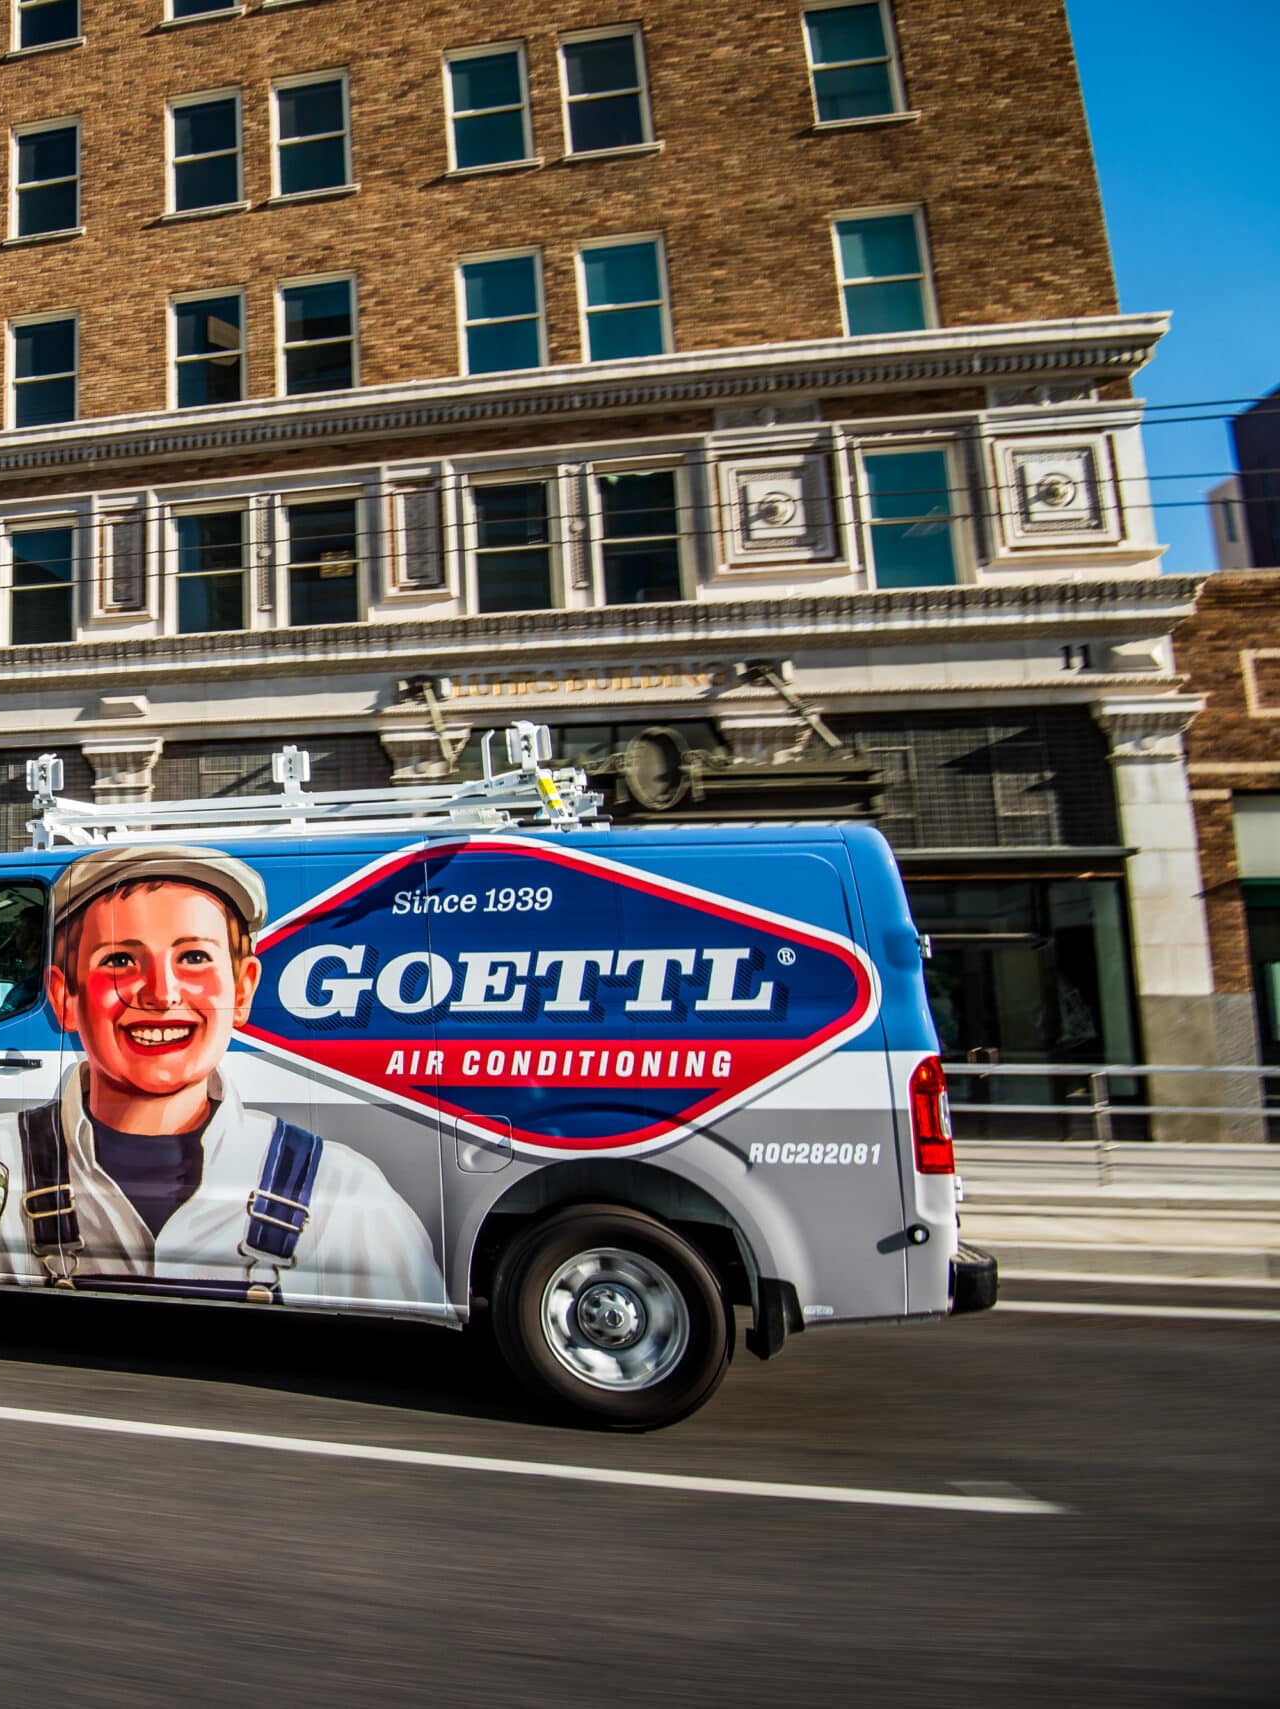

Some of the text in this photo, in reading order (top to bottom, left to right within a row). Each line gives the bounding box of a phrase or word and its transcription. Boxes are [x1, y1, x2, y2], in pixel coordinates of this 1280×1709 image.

[392, 886, 553, 914] Since 1939
[386, 1050, 732, 1078] AIR CONDITIONING
[748, 1142, 881, 1165] ROC282081
